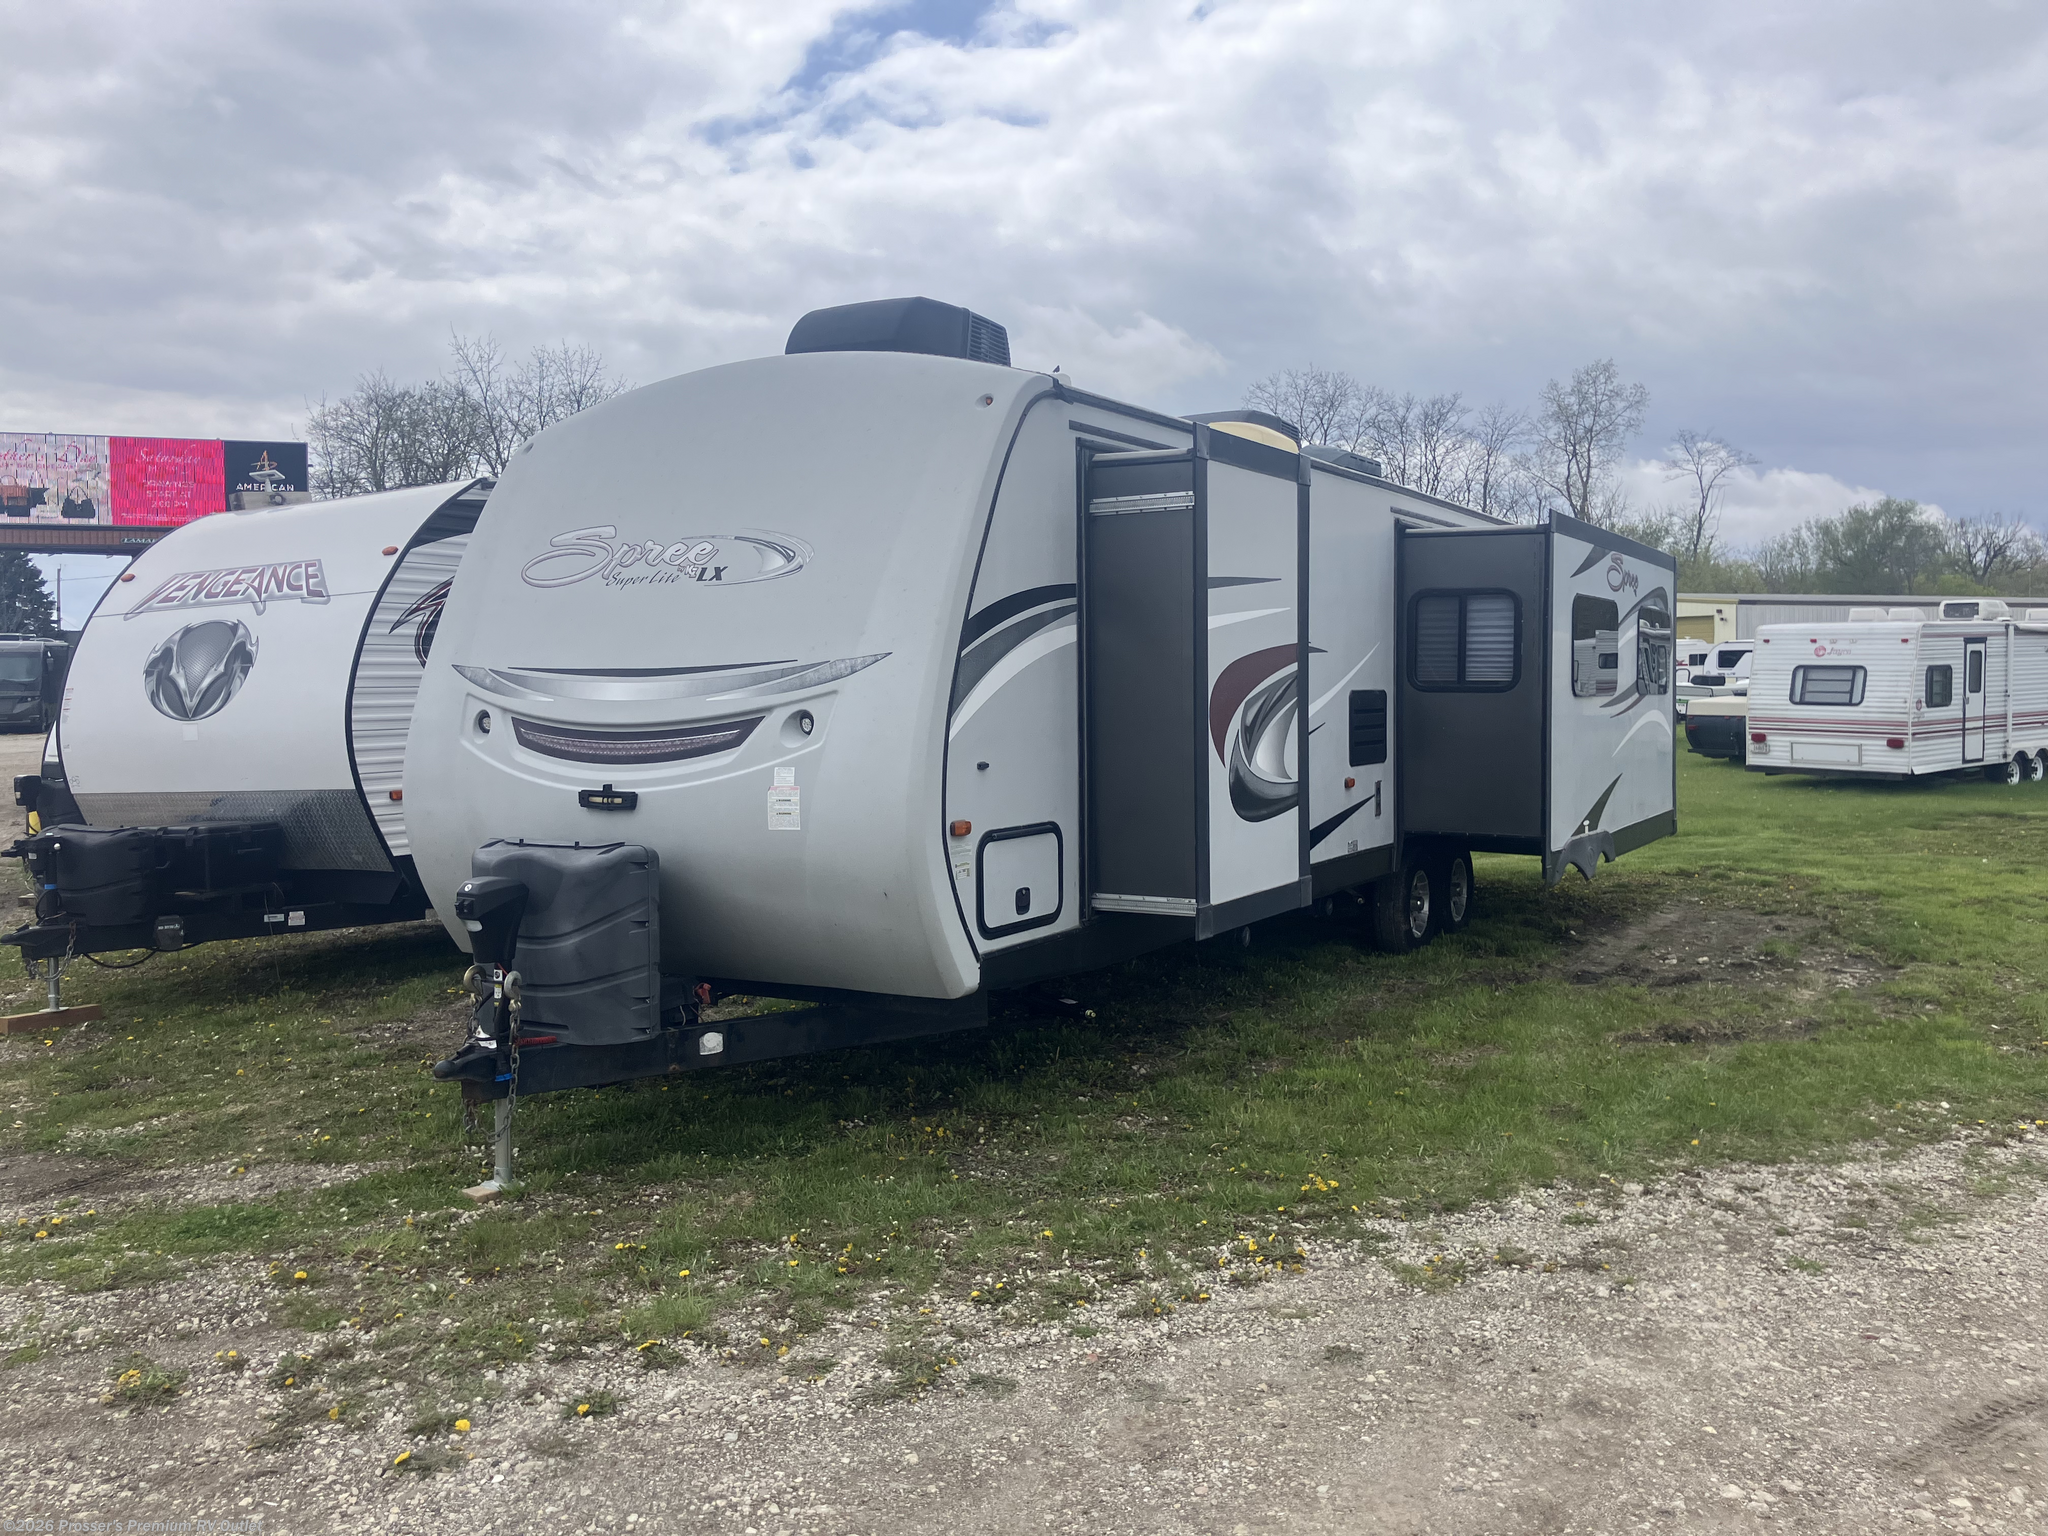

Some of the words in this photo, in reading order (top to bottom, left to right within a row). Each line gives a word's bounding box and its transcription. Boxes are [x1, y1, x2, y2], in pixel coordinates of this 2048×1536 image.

[235, 483, 294, 491] AMERCAN
[521, 525, 720, 588] Spree
[128, 561, 326, 614] VENGEANCE
[605, 571, 649, 591] Super
[649, 570, 681, 584] Lite
[696, 566, 729, 581] LX
